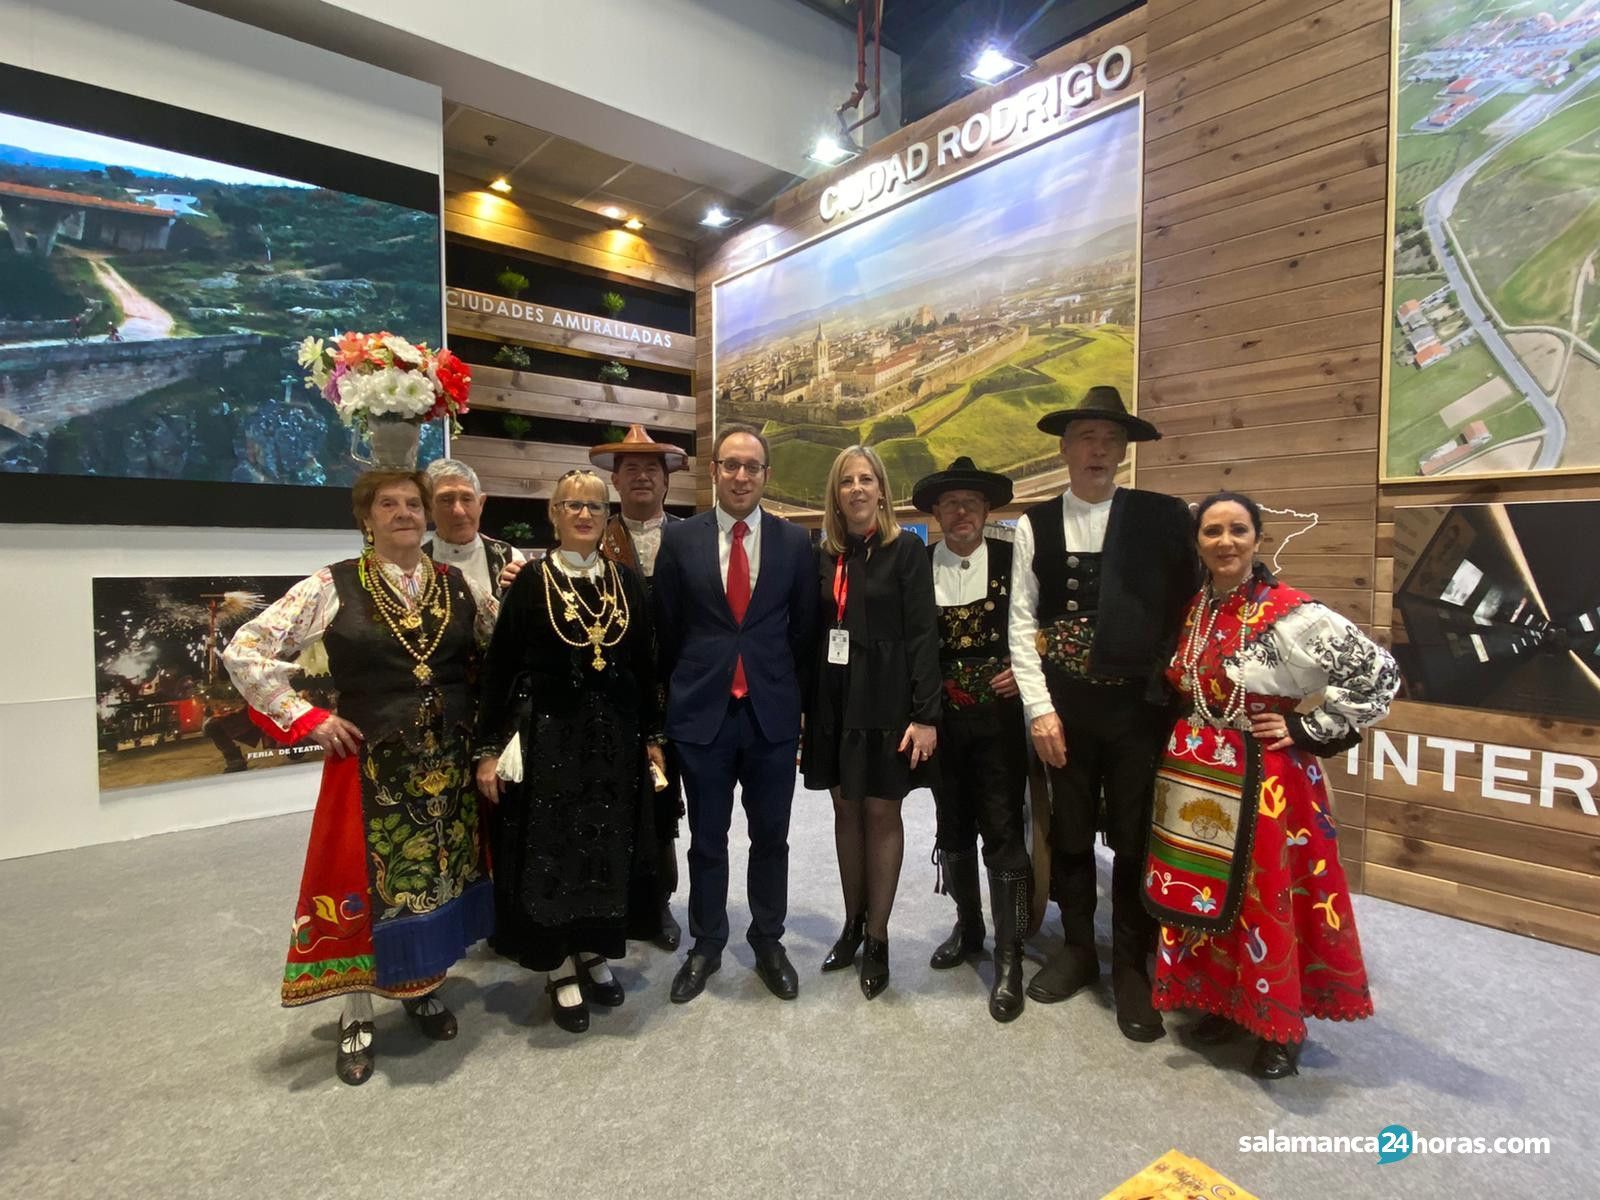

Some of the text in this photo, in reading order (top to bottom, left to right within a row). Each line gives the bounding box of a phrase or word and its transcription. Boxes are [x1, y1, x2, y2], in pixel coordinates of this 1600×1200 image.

[937, 45, 1132, 166] RODRIGO
[446, 290, 673, 349] CIUDADES AMURALLADAS
[247, 751, 274, 759] FERIA
[278, 748, 291, 756] DE
[1347, 727, 1599, 816] INTER
